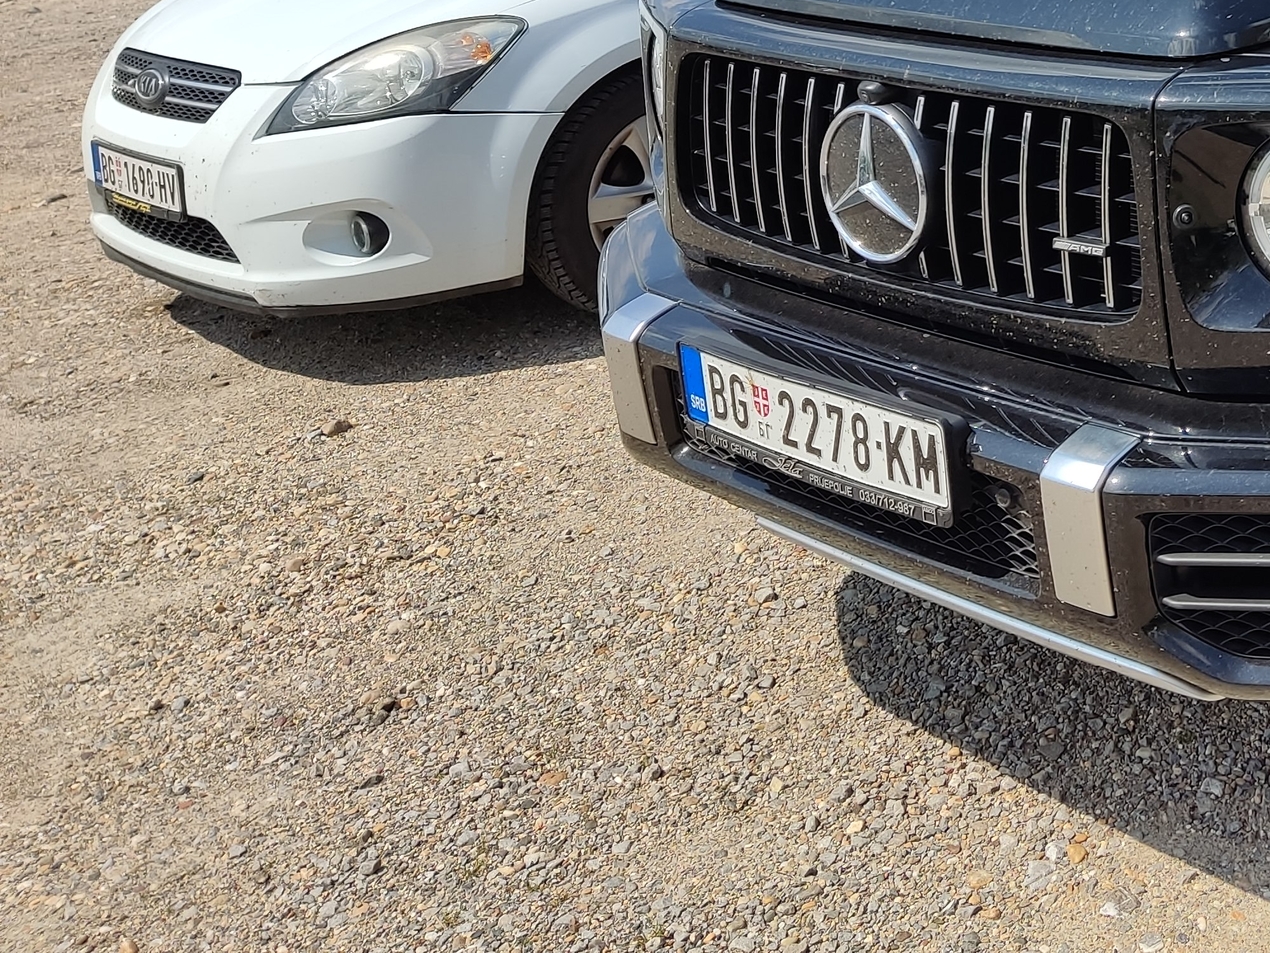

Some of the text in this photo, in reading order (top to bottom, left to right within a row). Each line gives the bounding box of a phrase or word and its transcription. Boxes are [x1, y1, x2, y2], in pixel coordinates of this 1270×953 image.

[101, 152, 116, 186] BG
[1068, 244, 1104, 256] AMG
[690, 394, 706, 412] SRB
[707, 363, 749, 429] BG
[710, 433, 729, 448] AUTO
[730, 442, 758, 461] CENTAR
[809, 473, 853, 497] PRIJEPOLJE
[859, 489, 915, 516] 033/712-987
